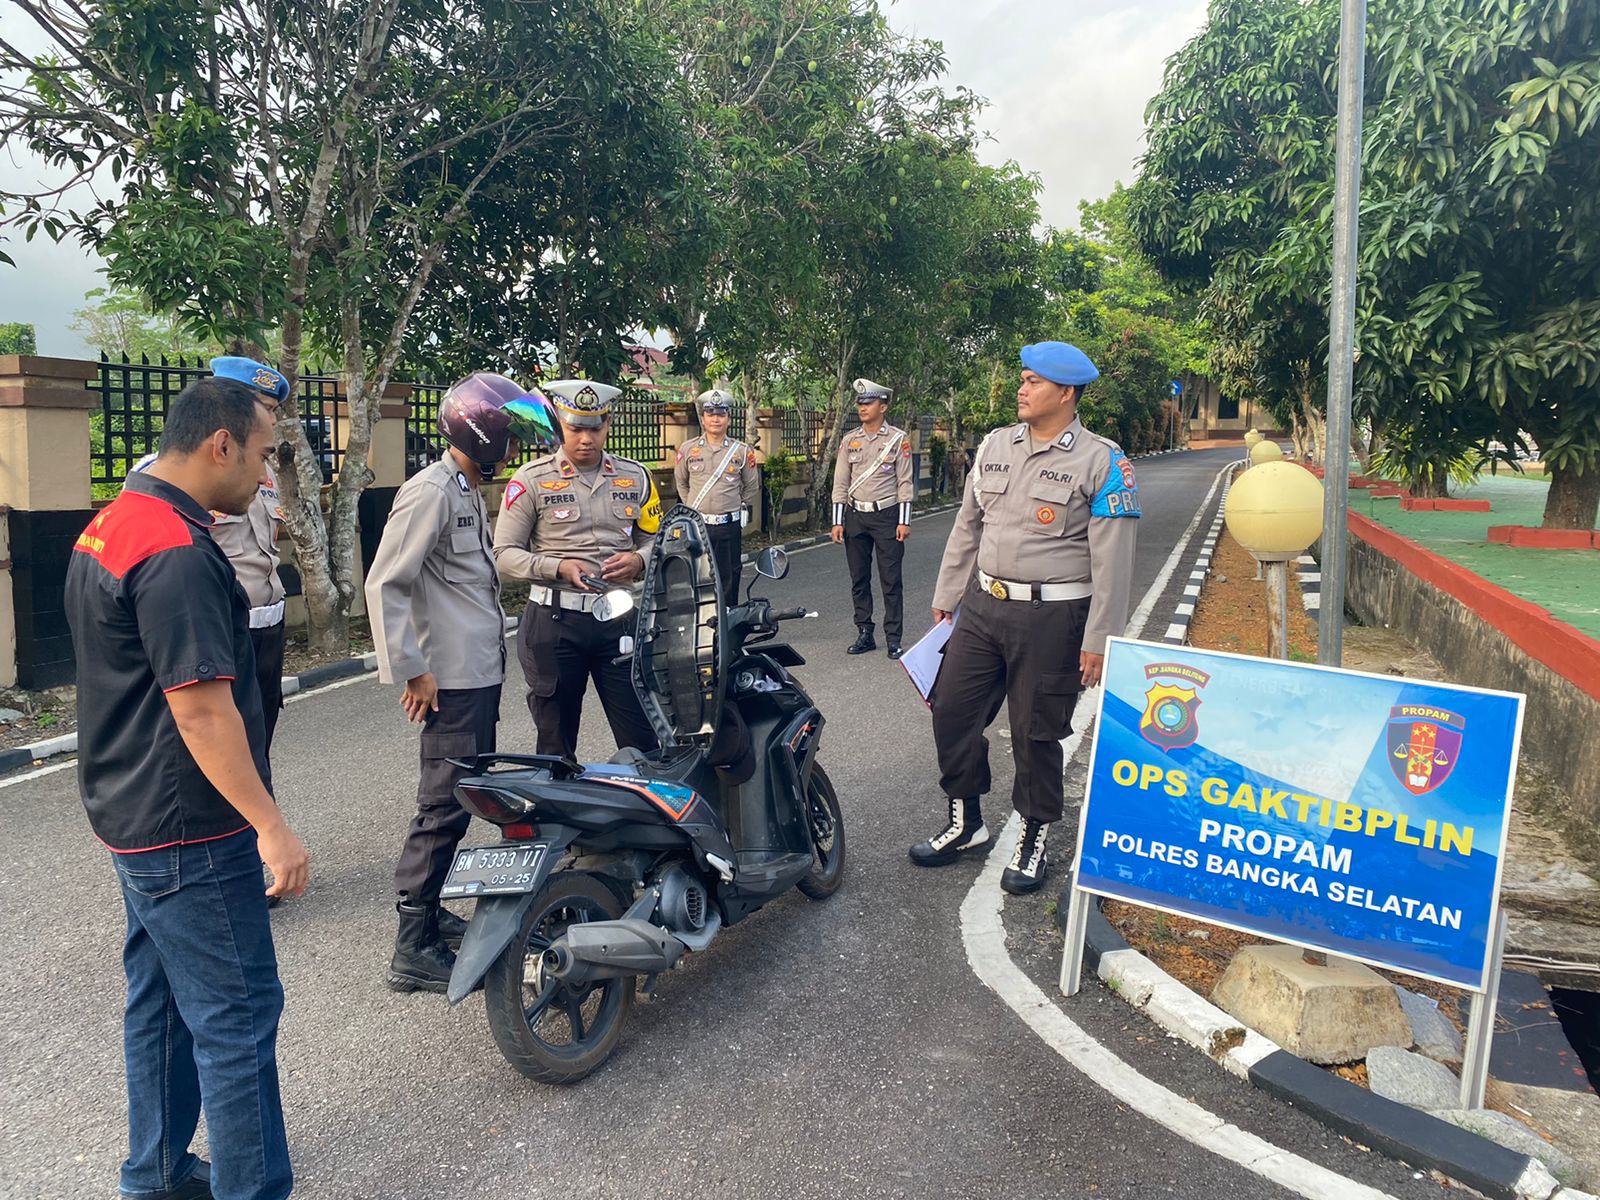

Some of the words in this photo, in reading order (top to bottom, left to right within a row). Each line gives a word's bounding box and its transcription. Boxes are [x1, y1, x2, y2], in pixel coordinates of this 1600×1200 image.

[1039, 469, 1073, 484] POLRI
[544, 494, 576, 505] PERES
[612, 491, 640, 501] POLRI
[1106, 490, 1140, 516] PR
[1402, 707, 1451, 721] PROPAM
[1111, 760, 1188, 797] OPS
[1201, 777, 1474, 856] GAKTIBPLIN
[1198, 818, 1353, 875] PROPAM
[479, 851, 517, 869] 5333
[522, 850, 541, 867] VI
[1102, 830, 1199, 868] POLRES
[1205, 854, 1320, 897] BANGKA
[1327, 881, 1463, 930] SELATAN
